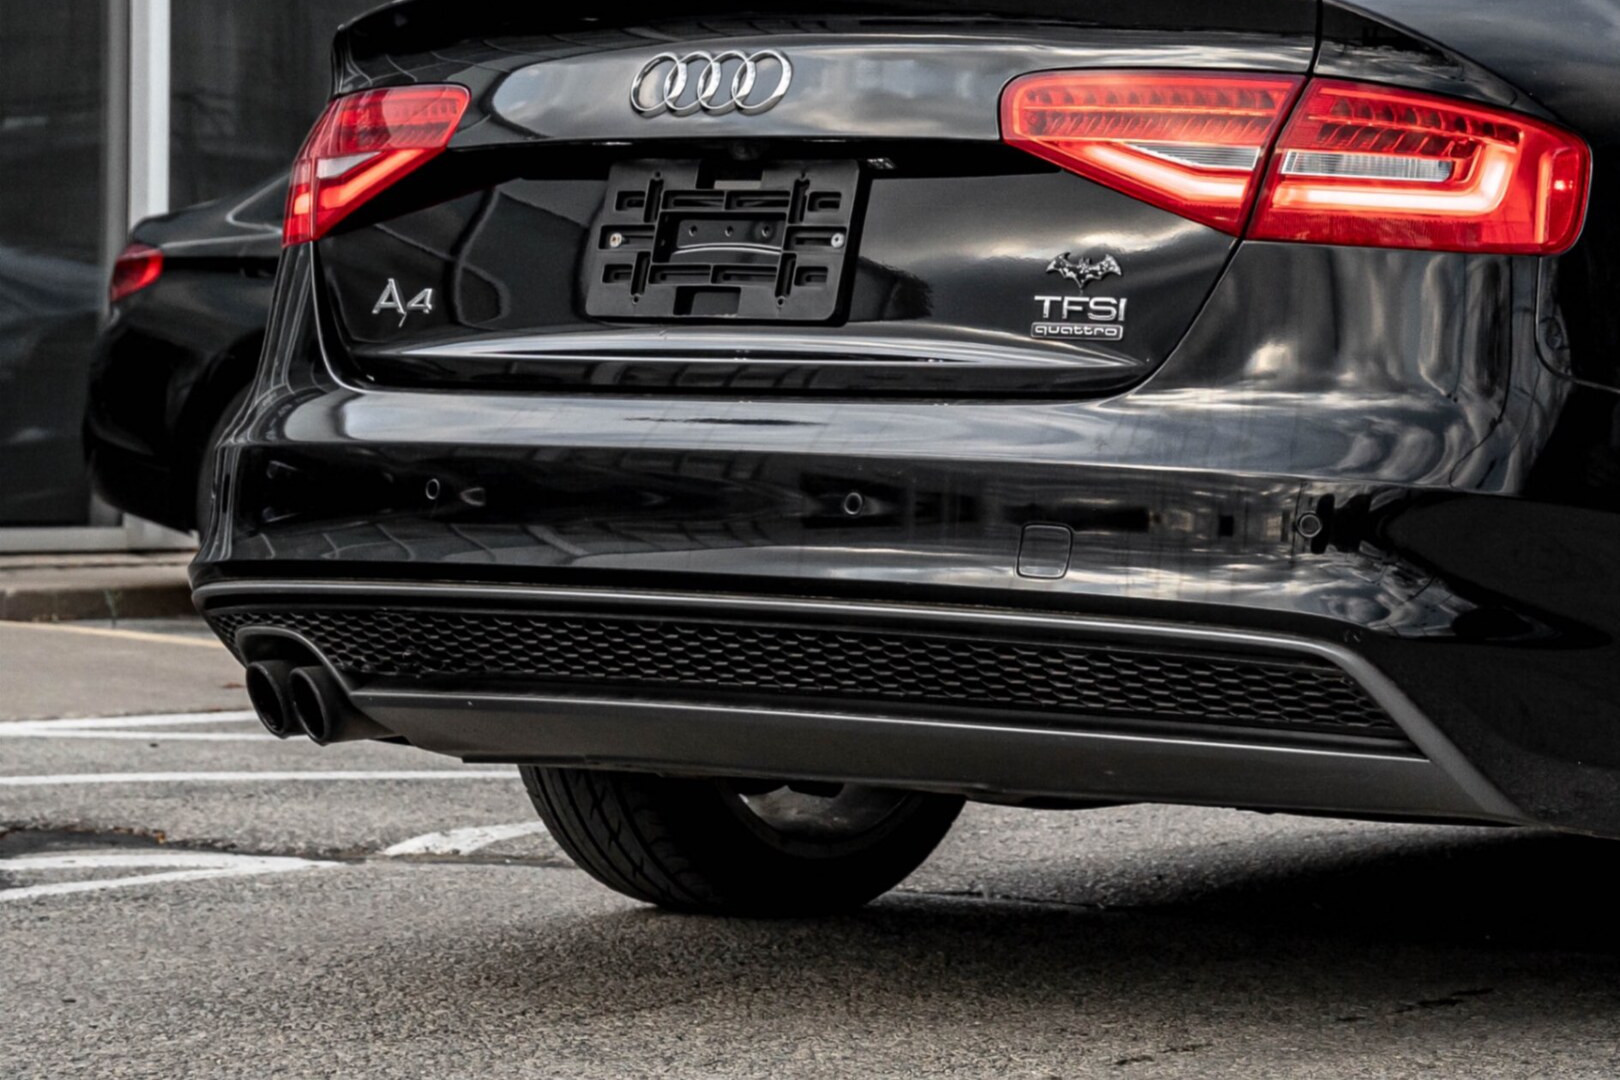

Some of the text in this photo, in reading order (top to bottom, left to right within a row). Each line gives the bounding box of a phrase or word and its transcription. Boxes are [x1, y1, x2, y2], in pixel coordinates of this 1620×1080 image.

[371, 277, 434, 328] A4
[1033, 295, 1128, 322] TFSI
[1033, 324, 1119, 337] quattro
